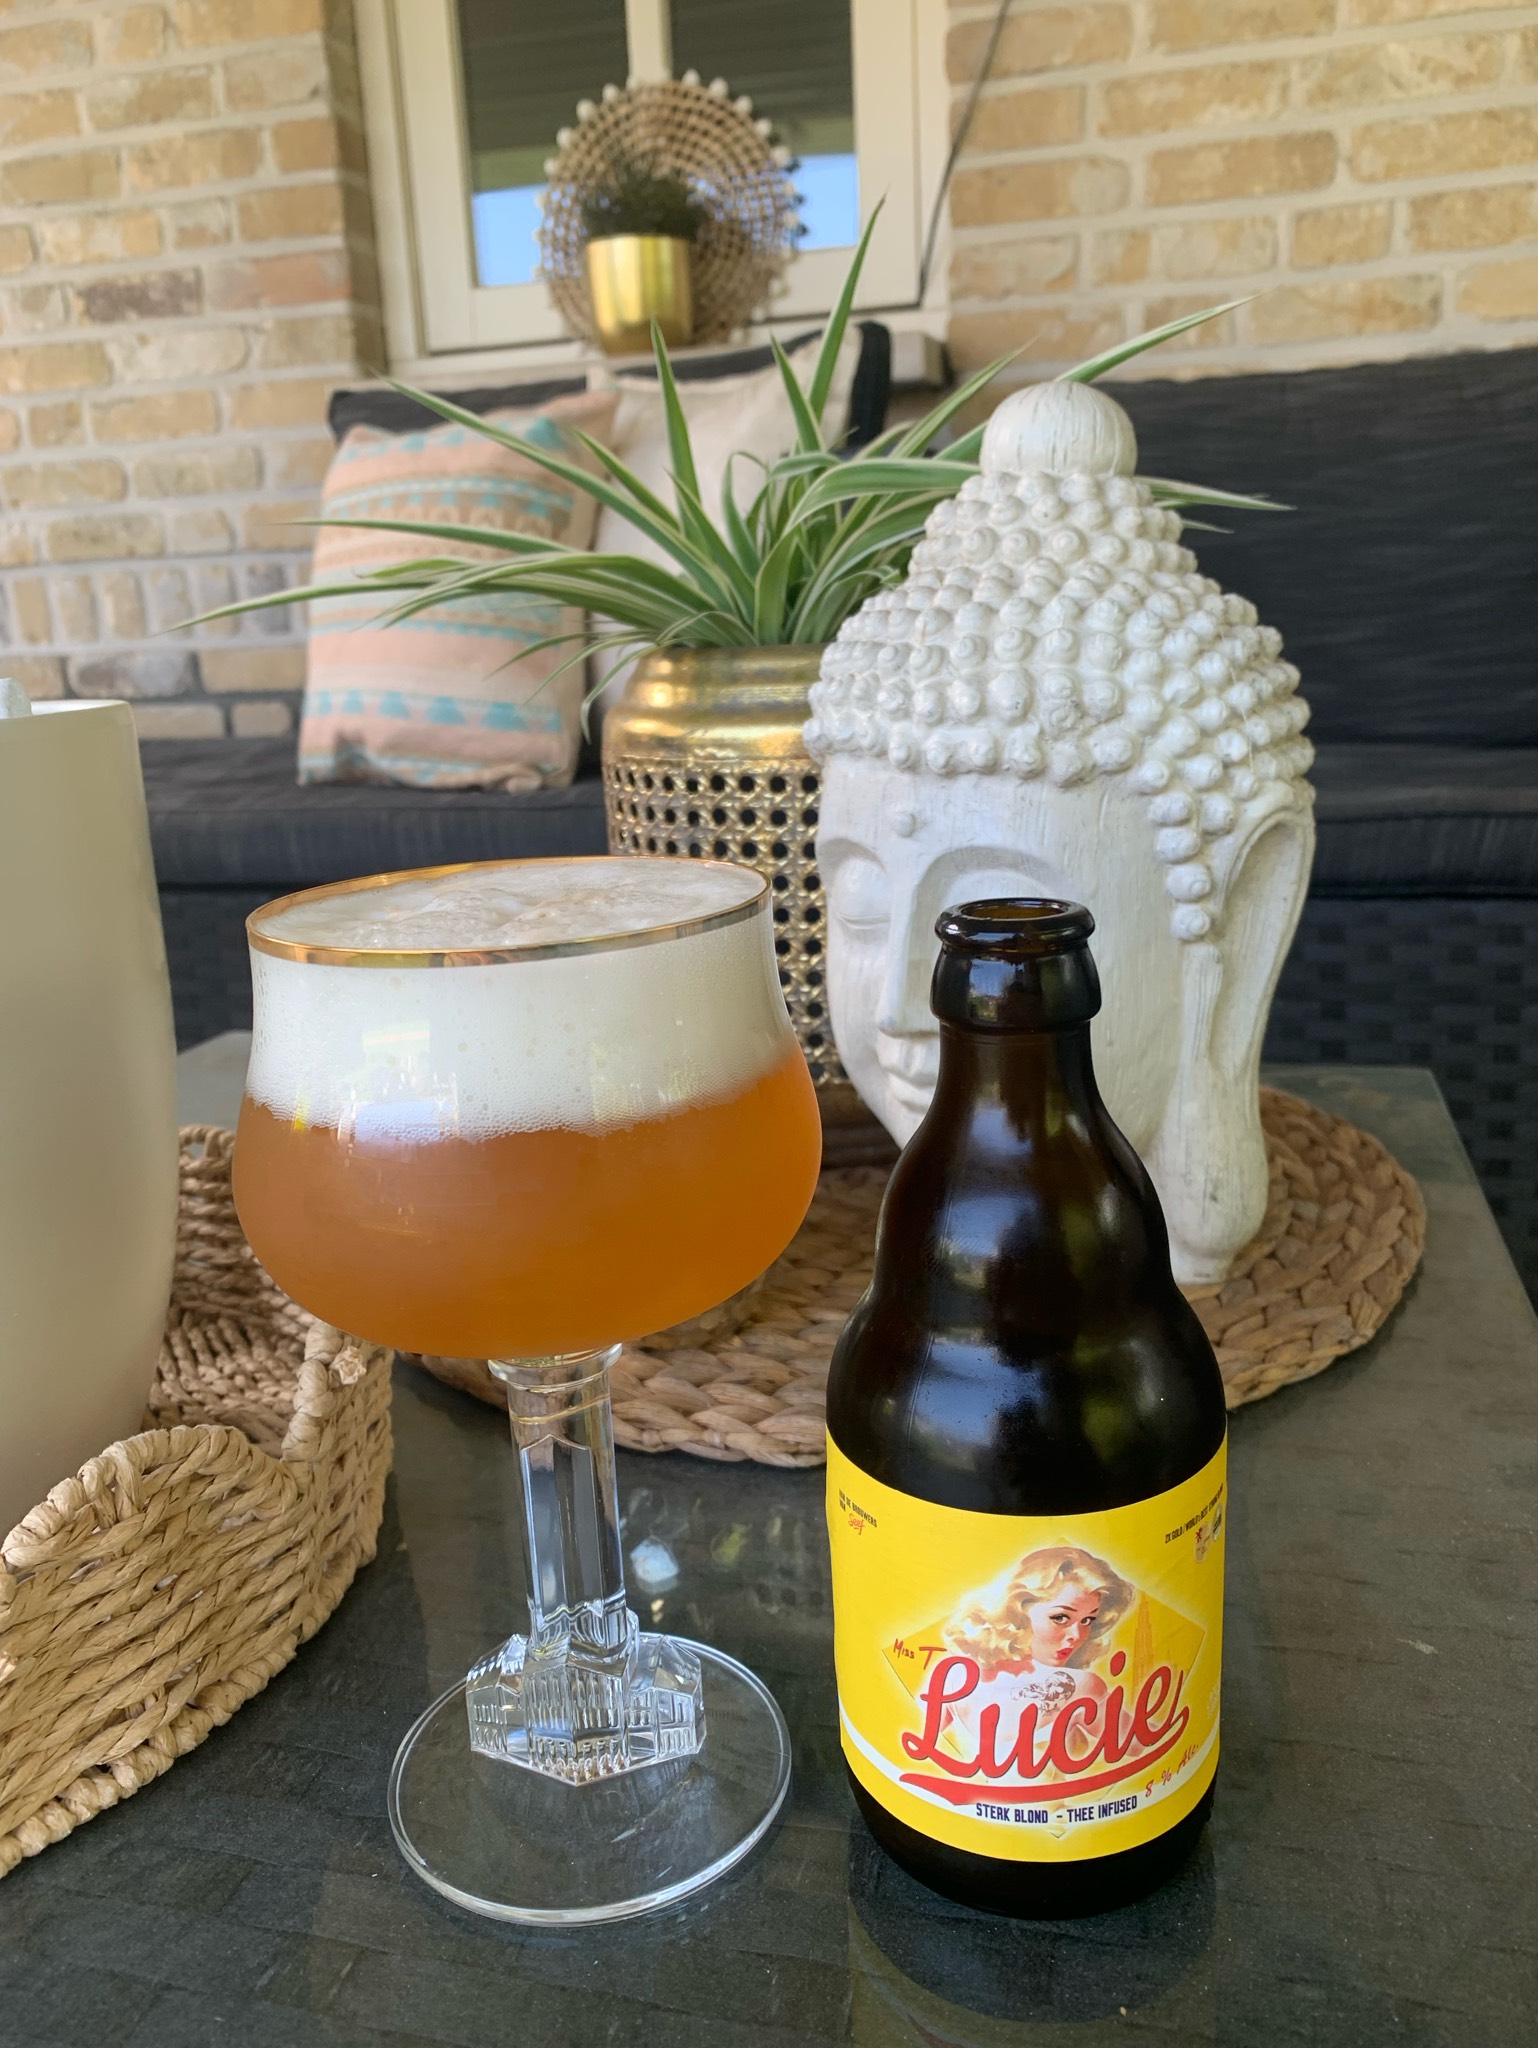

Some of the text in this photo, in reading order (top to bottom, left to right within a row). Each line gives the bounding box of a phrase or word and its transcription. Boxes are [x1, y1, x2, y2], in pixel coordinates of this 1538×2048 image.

[918, 1646, 947, 1670] T
[901, 1651, 1189, 1779] Lucie
[1145, 1779, 1154, 1798] 8
[1161, 1767, 1172, 1786] %
[976, 1803, 1010, 1822] STERK
[1014, 1808, 1048, 1824] BLOND
[1067, 1806, 1095, 1823] THEE
[1098, 1795, 1138, 1815] INFUSED
